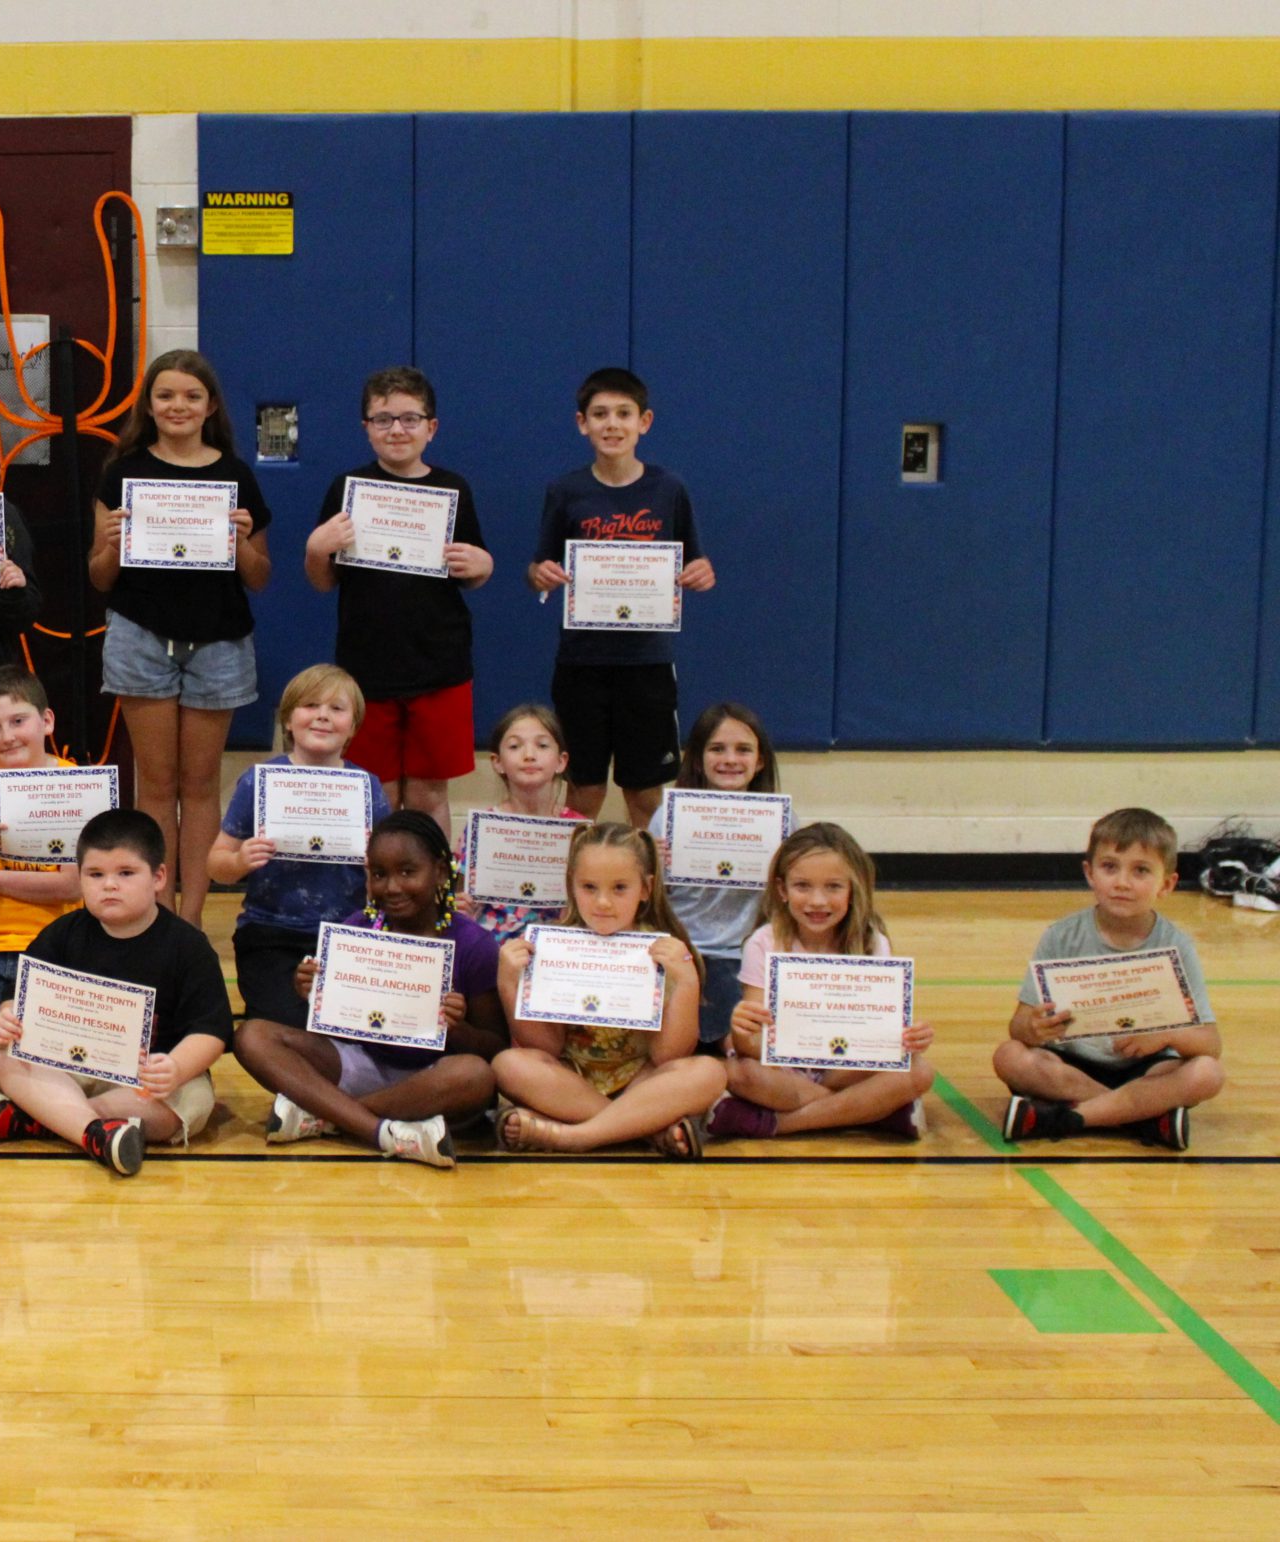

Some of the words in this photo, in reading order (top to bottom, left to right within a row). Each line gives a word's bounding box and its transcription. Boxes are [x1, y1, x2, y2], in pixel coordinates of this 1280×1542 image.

[207, 193, 289, 206] WARNING
[372, 518, 389, 526] MAX
[391, 520, 426, 530] RICKARD
[581, 516, 617, 540] Big
[612, 509, 663, 532] Wave
[29, 810, 60, 818] AURON
[63, 809, 82, 817] HINE
[284, 806, 320, 815] MACSEN
[322, 808, 348, 816] STONE
[727, 833, 762, 841] LENNON
[493, 852, 525, 861] ARIANA
[336, 943, 372, 955] STUDENT
[375, 948, 385, 956] OF
[388, 951, 402, 960] THE
[405, 954, 435, 964] MONTH
[355, 956, 393, 968] SEPTEMBER
[540, 960, 579, 969] MAISYN
[582, 962, 648, 974] DEMAGISTRIS
[335, 971, 367, 984] ZIARRA
[370, 977, 431, 993] BLANCHARD
[787, 972, 828, 980] STUDENT
[831, 973, 841, 981] OF
[845, 974, 861, 982] THE
[864, 975, 895, 983] MONTH
[35, 978, 73, 993] STUDENT
[90, 991, 104, 1000] THE
[107, 996, 136, 1008] MONTH
[784, 1000, 822, 1009] PAISLEY
[848, 1004, 896, 1012] NOSTRAND
[1072, 997, 1106, 1009] TYLER
[38, 1006, 81, 1024] ROSARIO
[83, 1017, 126, 1032] MESSINA
